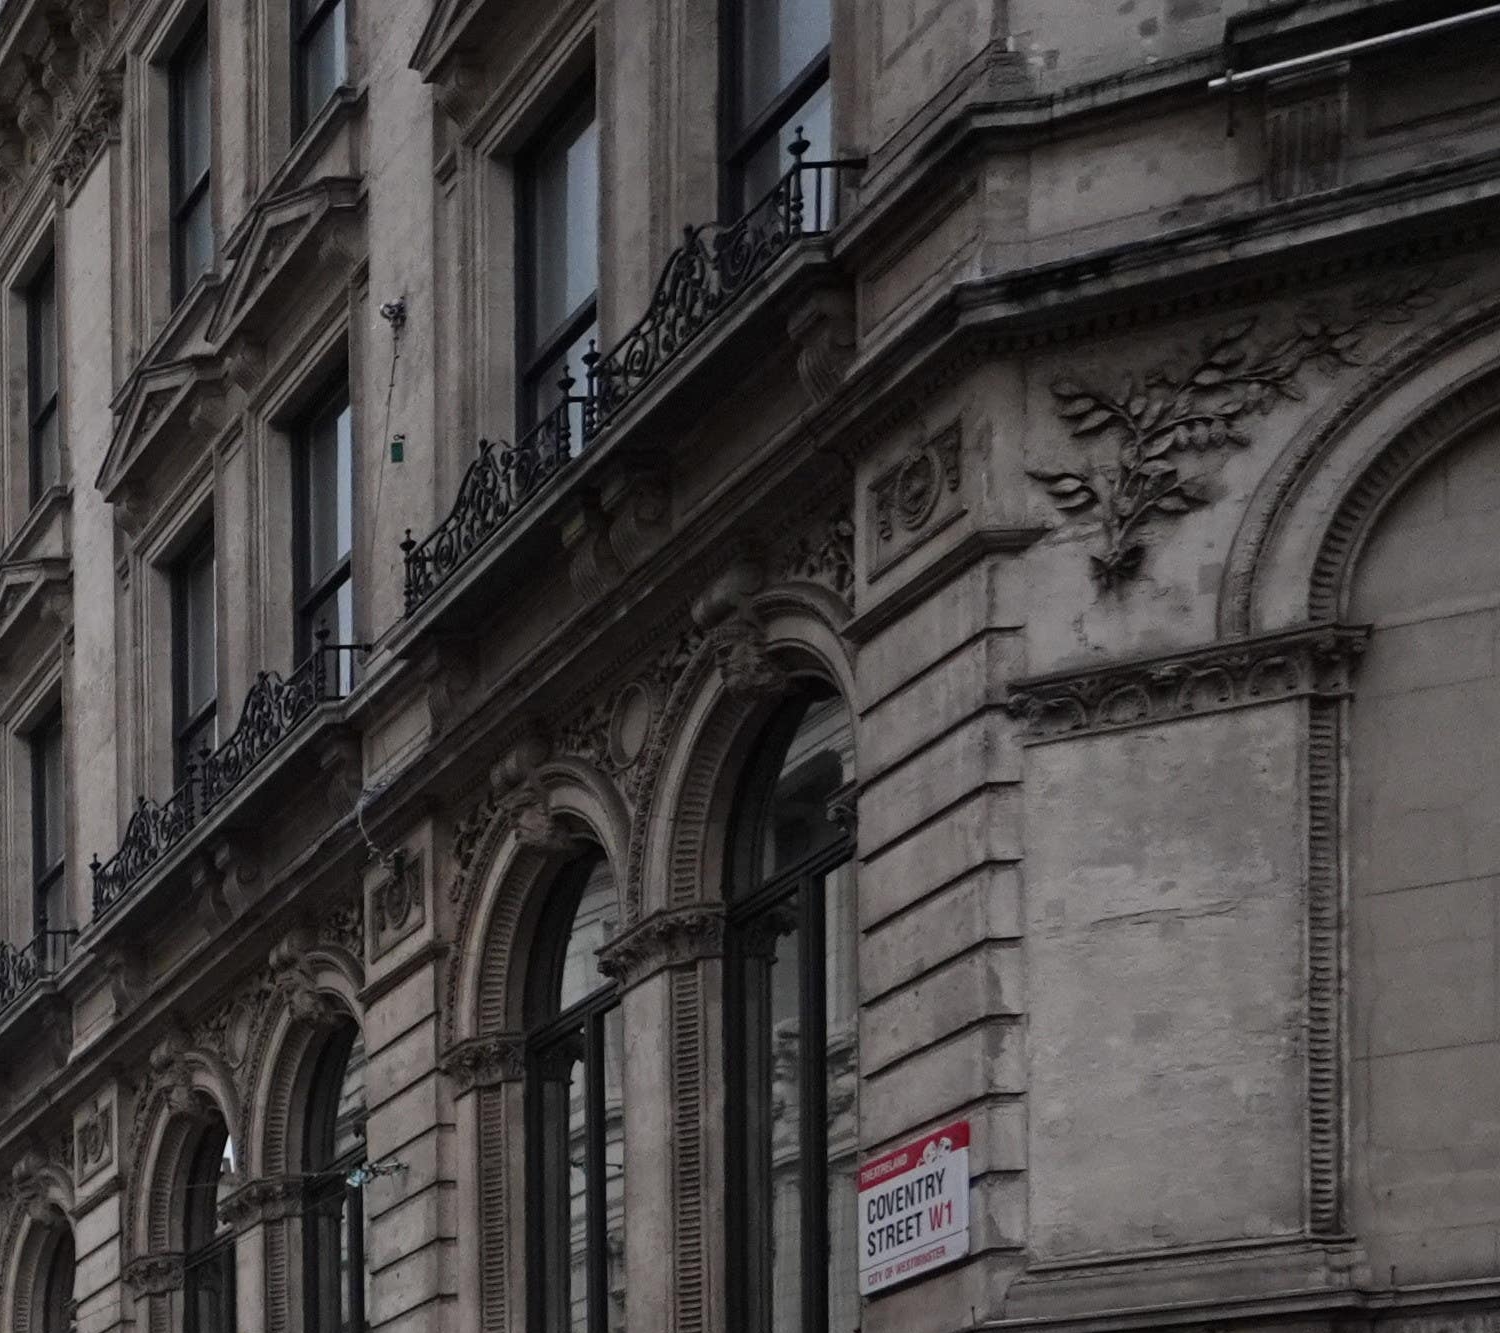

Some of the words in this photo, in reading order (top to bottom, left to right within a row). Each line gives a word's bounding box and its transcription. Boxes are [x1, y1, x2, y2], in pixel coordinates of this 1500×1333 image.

[861, 1153, 909, 1185] THEATRELAND
[867, 1168, 946, 1225] COVENTRY
[867, 1211, 923, 1258] STREET
[928, 1200, 953, 1232] W1
[868, 1269, 883, 1287] CITY
[895, 1245, 946, 1274] WESTMINSTER
